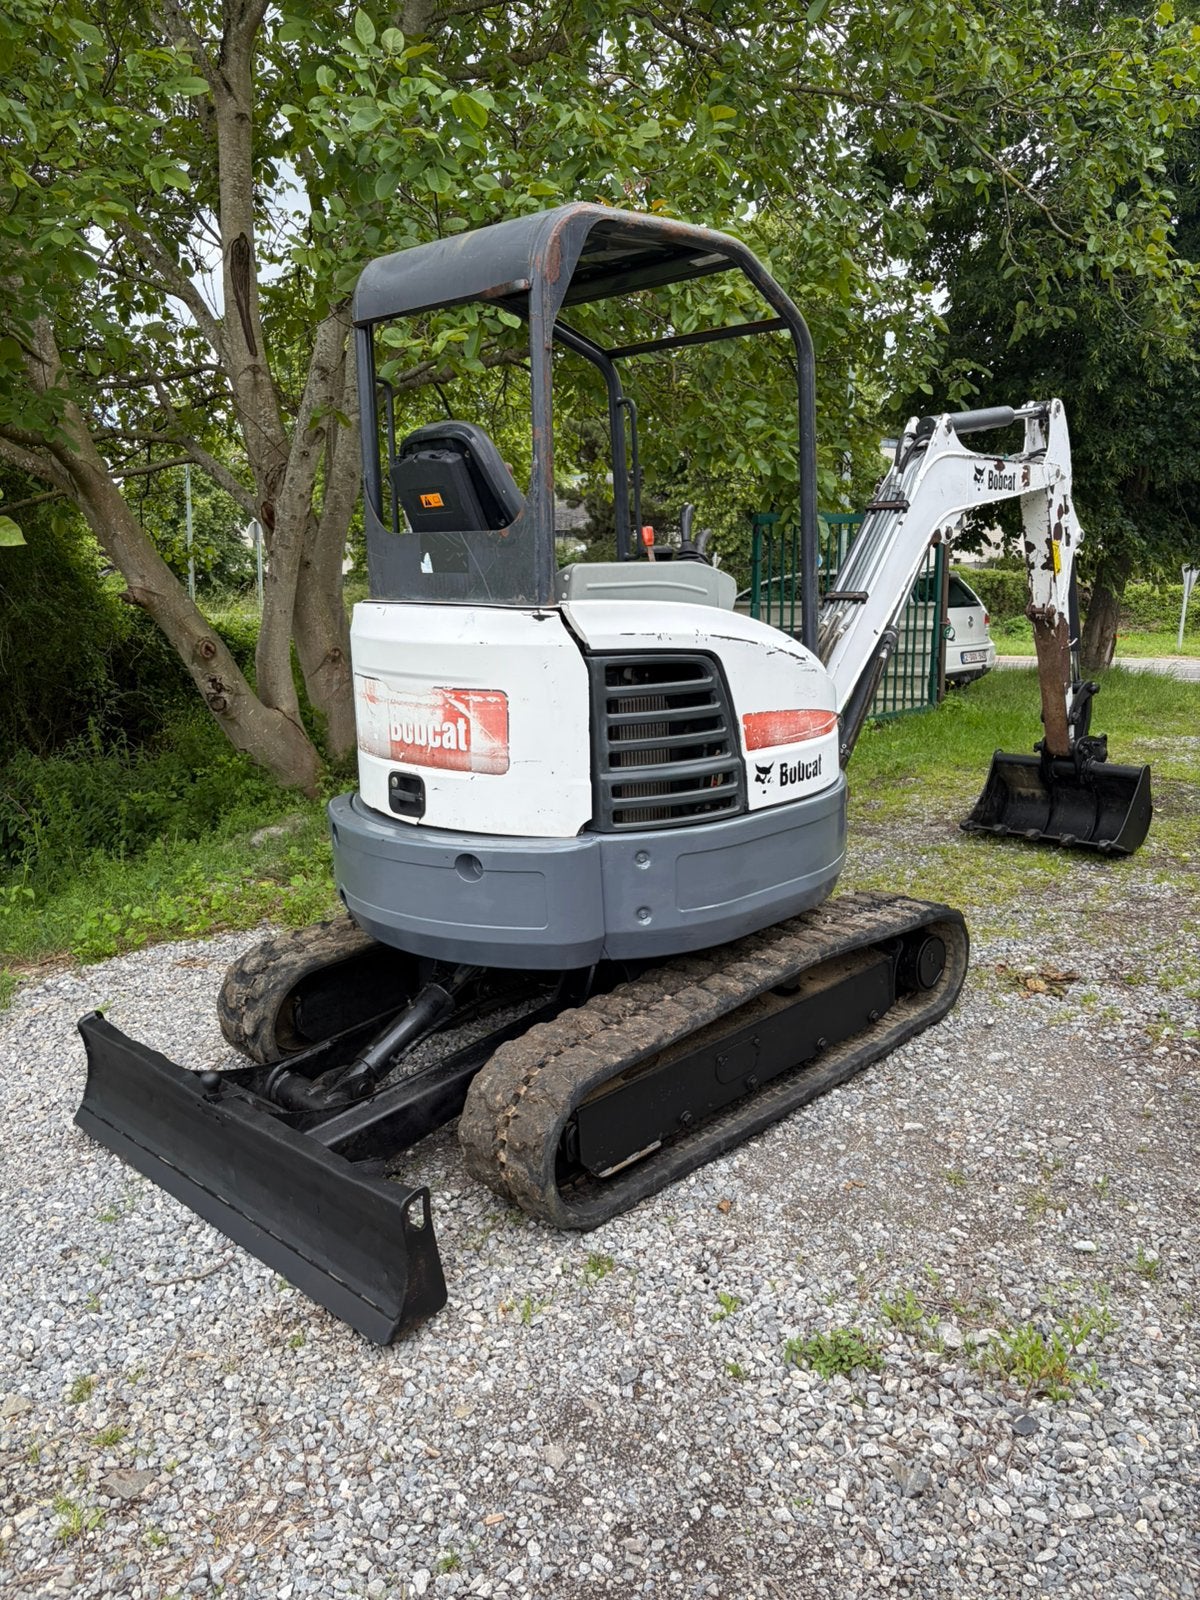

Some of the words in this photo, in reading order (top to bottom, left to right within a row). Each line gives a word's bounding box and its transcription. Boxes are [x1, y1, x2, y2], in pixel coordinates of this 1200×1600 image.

[988, 470, 1016, 491] Bobcat
[390, 713, 468, 751] Bobcat
[780, 754, 822, 787] Bobcat
